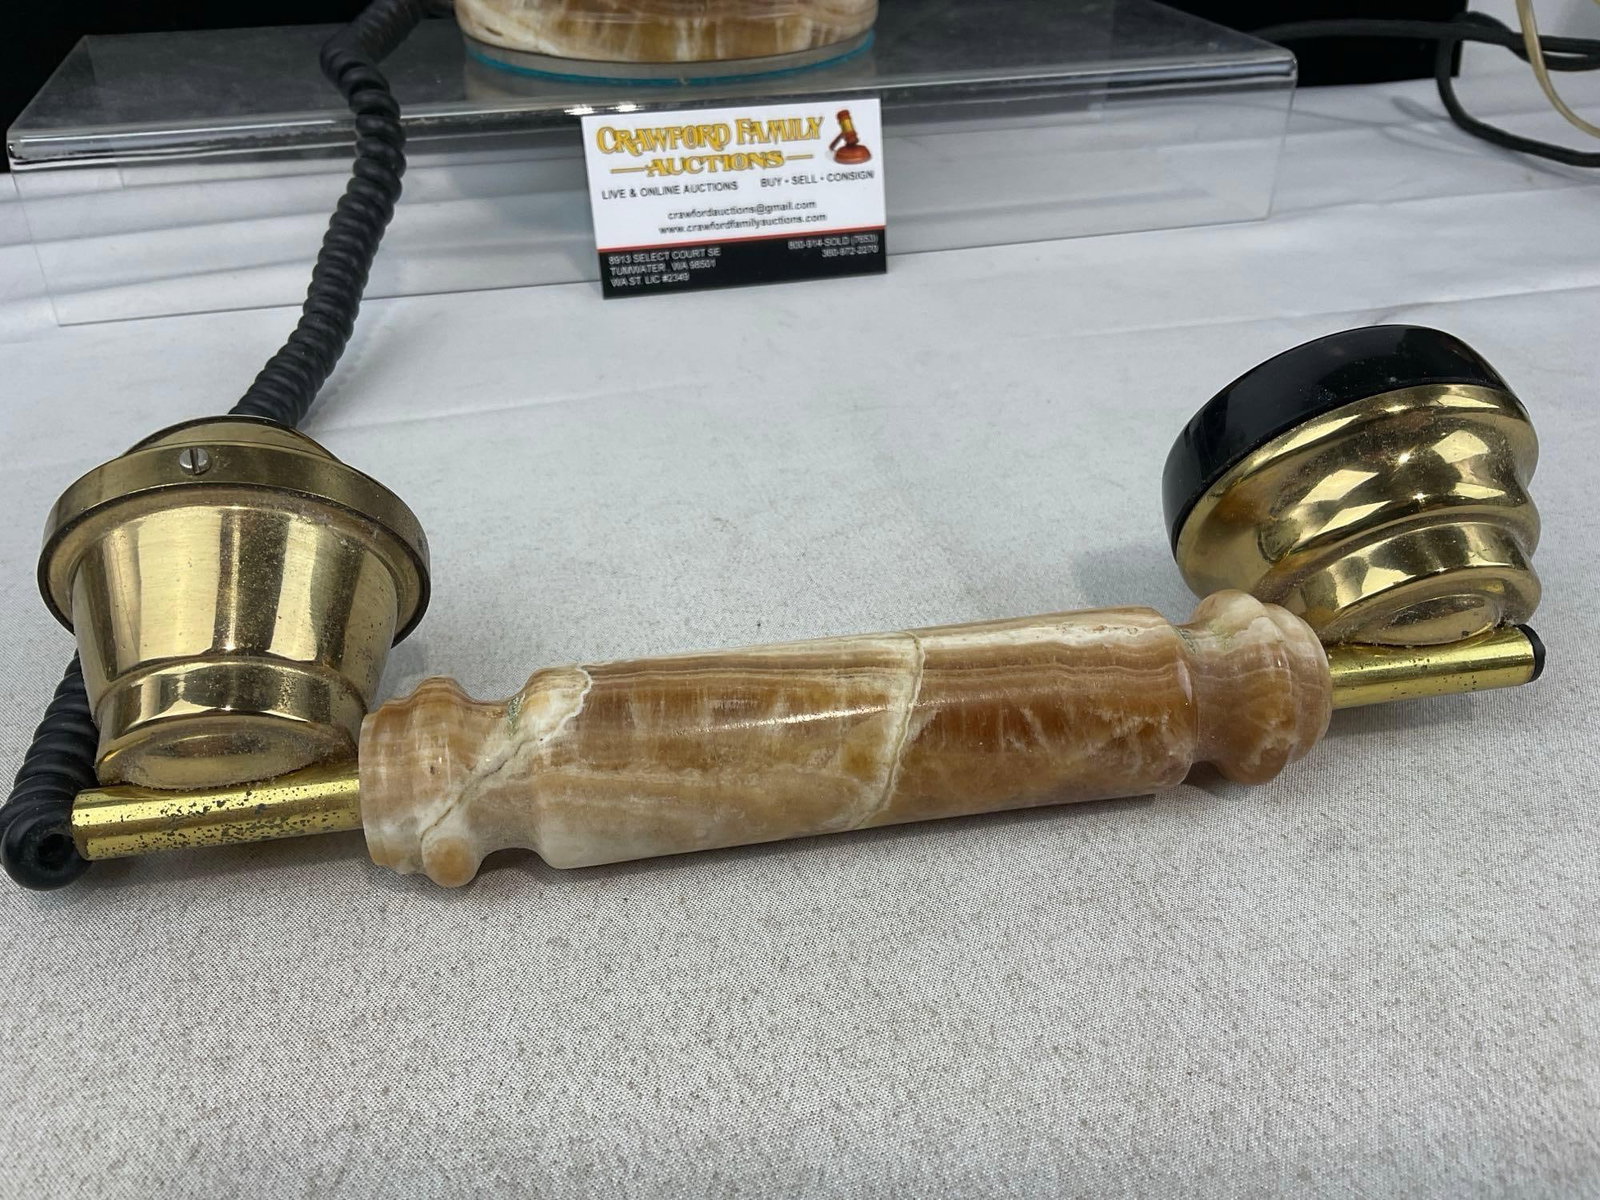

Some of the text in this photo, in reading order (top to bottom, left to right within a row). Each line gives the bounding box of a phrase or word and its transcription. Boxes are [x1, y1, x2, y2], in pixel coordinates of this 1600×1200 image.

[596, 116, 825, 156] CRAWFORD FAMILY
[647, 151, 785, 176] AUCTIONS
[760, 170, 875, 188] BUY SELL CONSIGN
[602, 181, 738, 200] LIVE & ONLINE AUCTIONS
[667, 200, 817, 220] crawfordauctions@gmail.com
[659, 213, 828, 234] www.crawfordfamilyauctions.com
[633, 251, 670, 263] SELECT
[671, 248, 705, 260] COURT
[707, 247, 721, 257] SE
[671, 260, 688, 271] WA
[610, 277, 628, 288] WA
